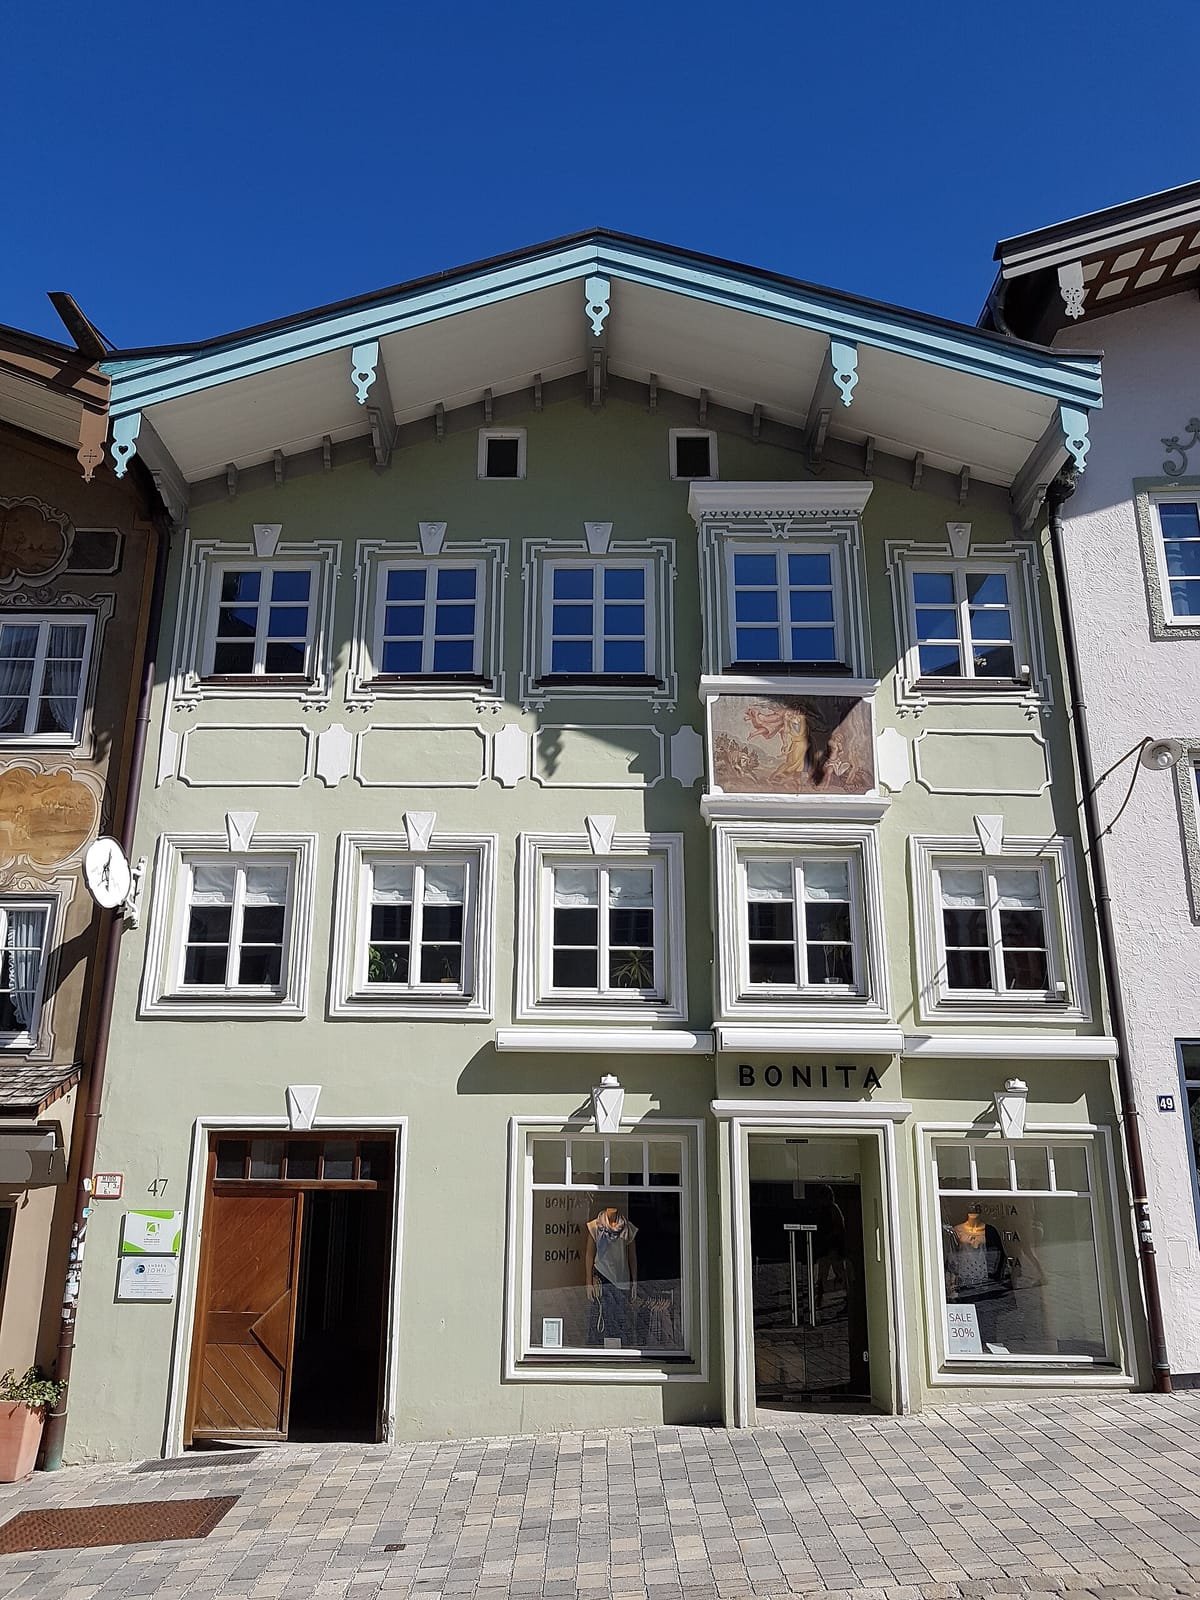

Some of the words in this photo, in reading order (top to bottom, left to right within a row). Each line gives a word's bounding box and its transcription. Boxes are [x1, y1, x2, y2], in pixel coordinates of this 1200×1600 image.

[738, 1064, 882, 1088] BONITA
[1159, 1097, 1174, 1110] 49
[147, 1178, 169, 1197] 47
[545, 1196, 581, 1211] BONITA
[545, 1221, 581, 1237] BONITA
[545, 1248, 581, 1264] BONITA
[948, 1312, 973, 1323] SALE
[951, 1327, 975, 1338] 30%
